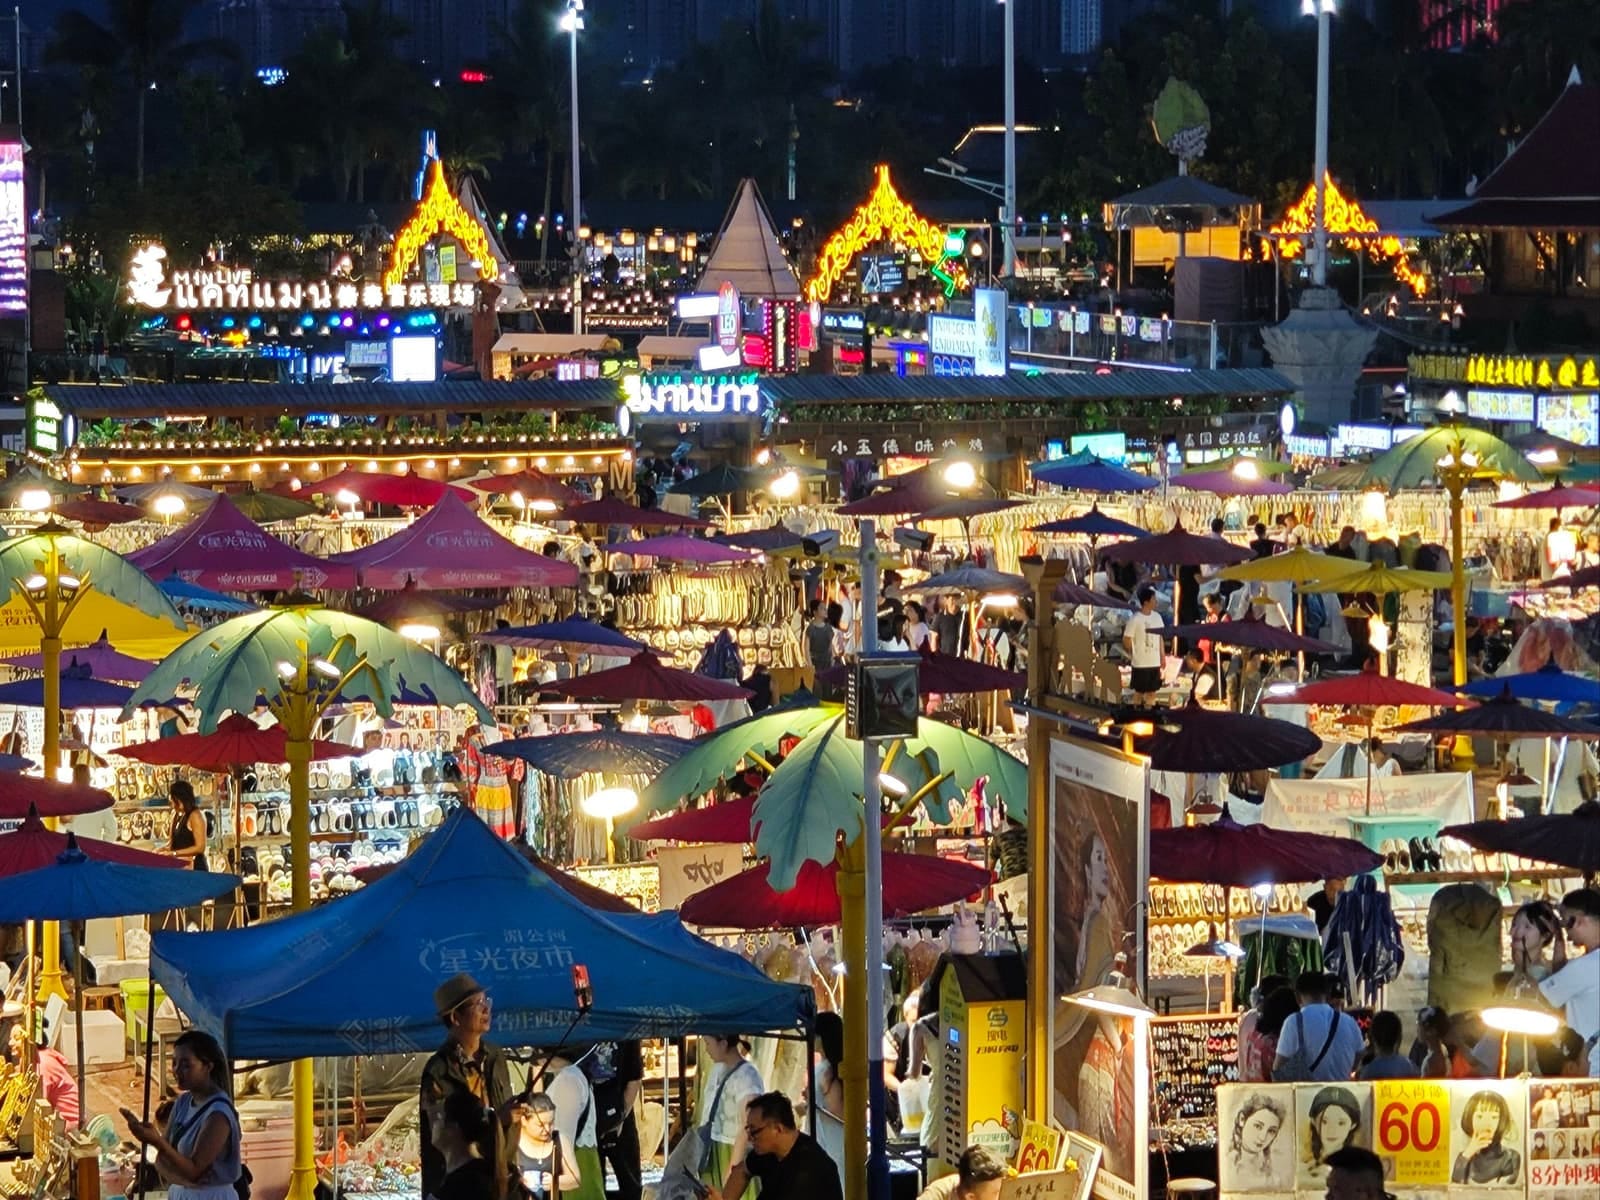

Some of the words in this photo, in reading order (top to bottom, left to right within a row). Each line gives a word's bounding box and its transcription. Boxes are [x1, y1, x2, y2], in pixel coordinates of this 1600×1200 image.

[217, 270, 252, 284] LIVE
[642, 376, 682, 387] LIVE
[694, 376, 749, 387] MUSIC
[440, 945, 575, 973] 星光夜市
[1379, 1102, 1441, 1152] 60
[1018, 1142, 1050, 1173] 60
